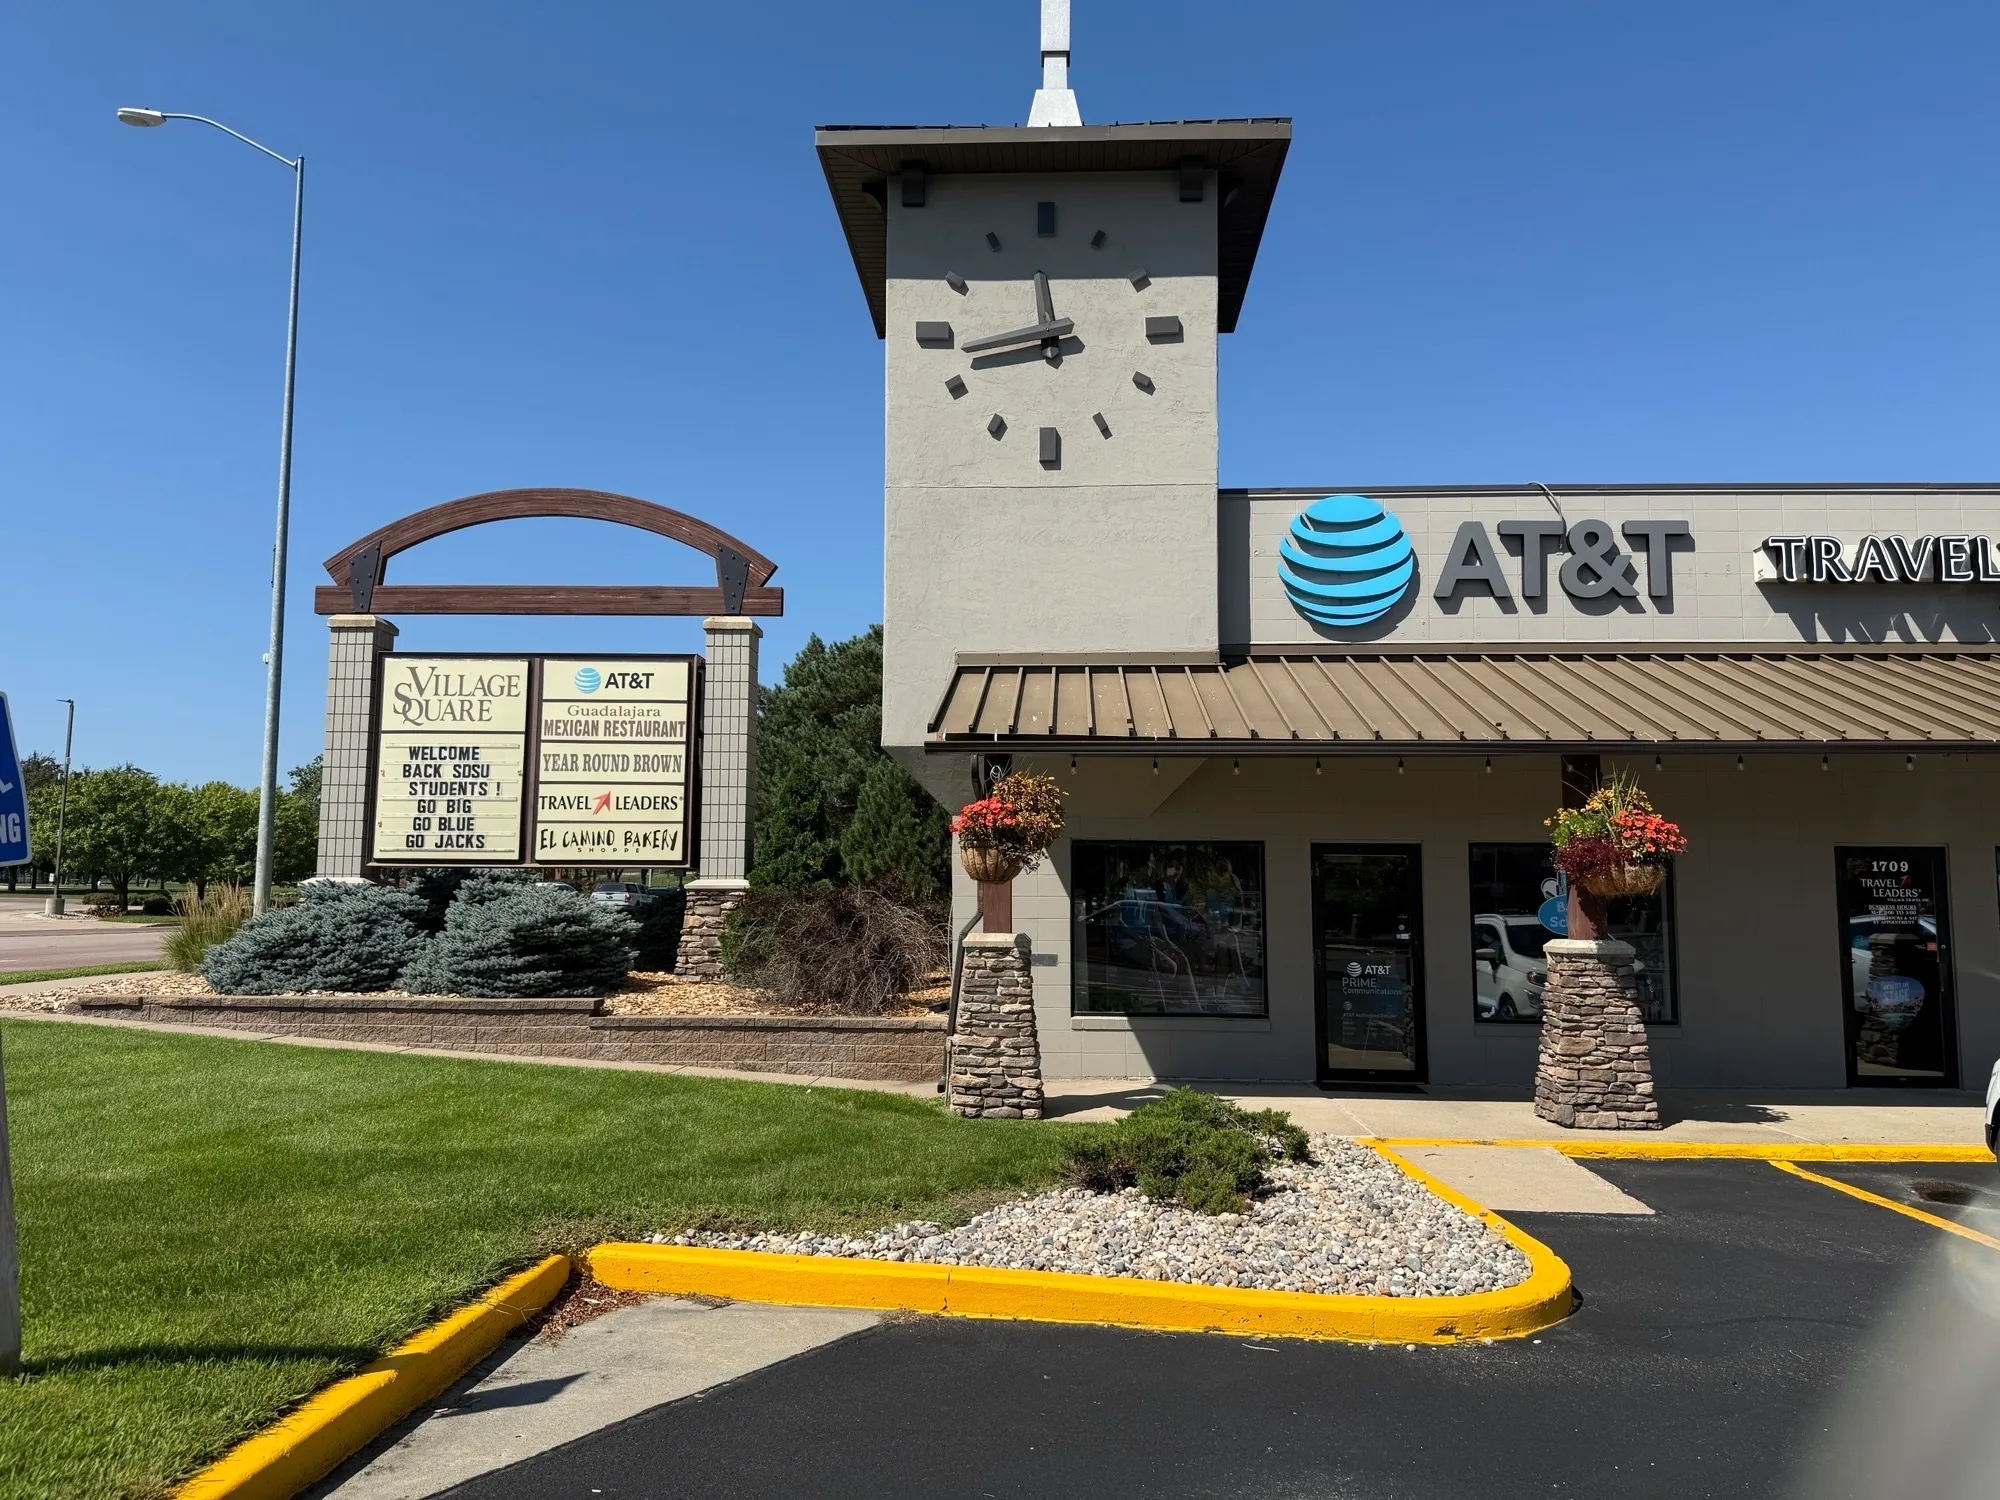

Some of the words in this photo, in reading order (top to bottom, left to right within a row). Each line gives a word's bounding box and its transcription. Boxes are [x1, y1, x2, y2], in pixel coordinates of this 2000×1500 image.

[1433, 519, 1690, 598] AT&T
[406, 666, 521, 698] VILLAGE
[604, 672, 655, 689] AT&T
[393, 682, 493, 726] SQUARE
[567, 705, 661, 719] Guadalajara
[543, 719, 599, 737] MEXICAN
[603, 720, 686, 738] RESTAURANT
[408, 746, 480, 760] WELCOME
[543, 753, 579, 772] YEAR
[582, 754, 630, 773] ROUND
[633, 754, 682, 773] BROWN
[402, 764, 443, 778] BACK
[452, 764, 490, 778] SDSU
[408, 781, 488, 796] STUDENTS
[417, 799, 436, 813] GO
[446, 799, 472, 813] BIG
[539, 795, 592, 810] TRAVEL
[412, 817, 431, 831] GO
[438, 817, 475, 831] BLUE
[406, 834, 425, 848] GO
[434, 834, 485, 848] JACKS
[540, 829, 557, 850] EL
[562, 829, 615, 848] CAMINO
[624, 829, 678, 851] BAKERY
[1871, 861, 1909, 872] 1709
[1860, 878, 1899, 888] TRAVEL
[1364, 965, 1392, 975] AT&T
[1342, 977, 1377, 988] PRIME
[1342, 987, 1402, 996] Communications
